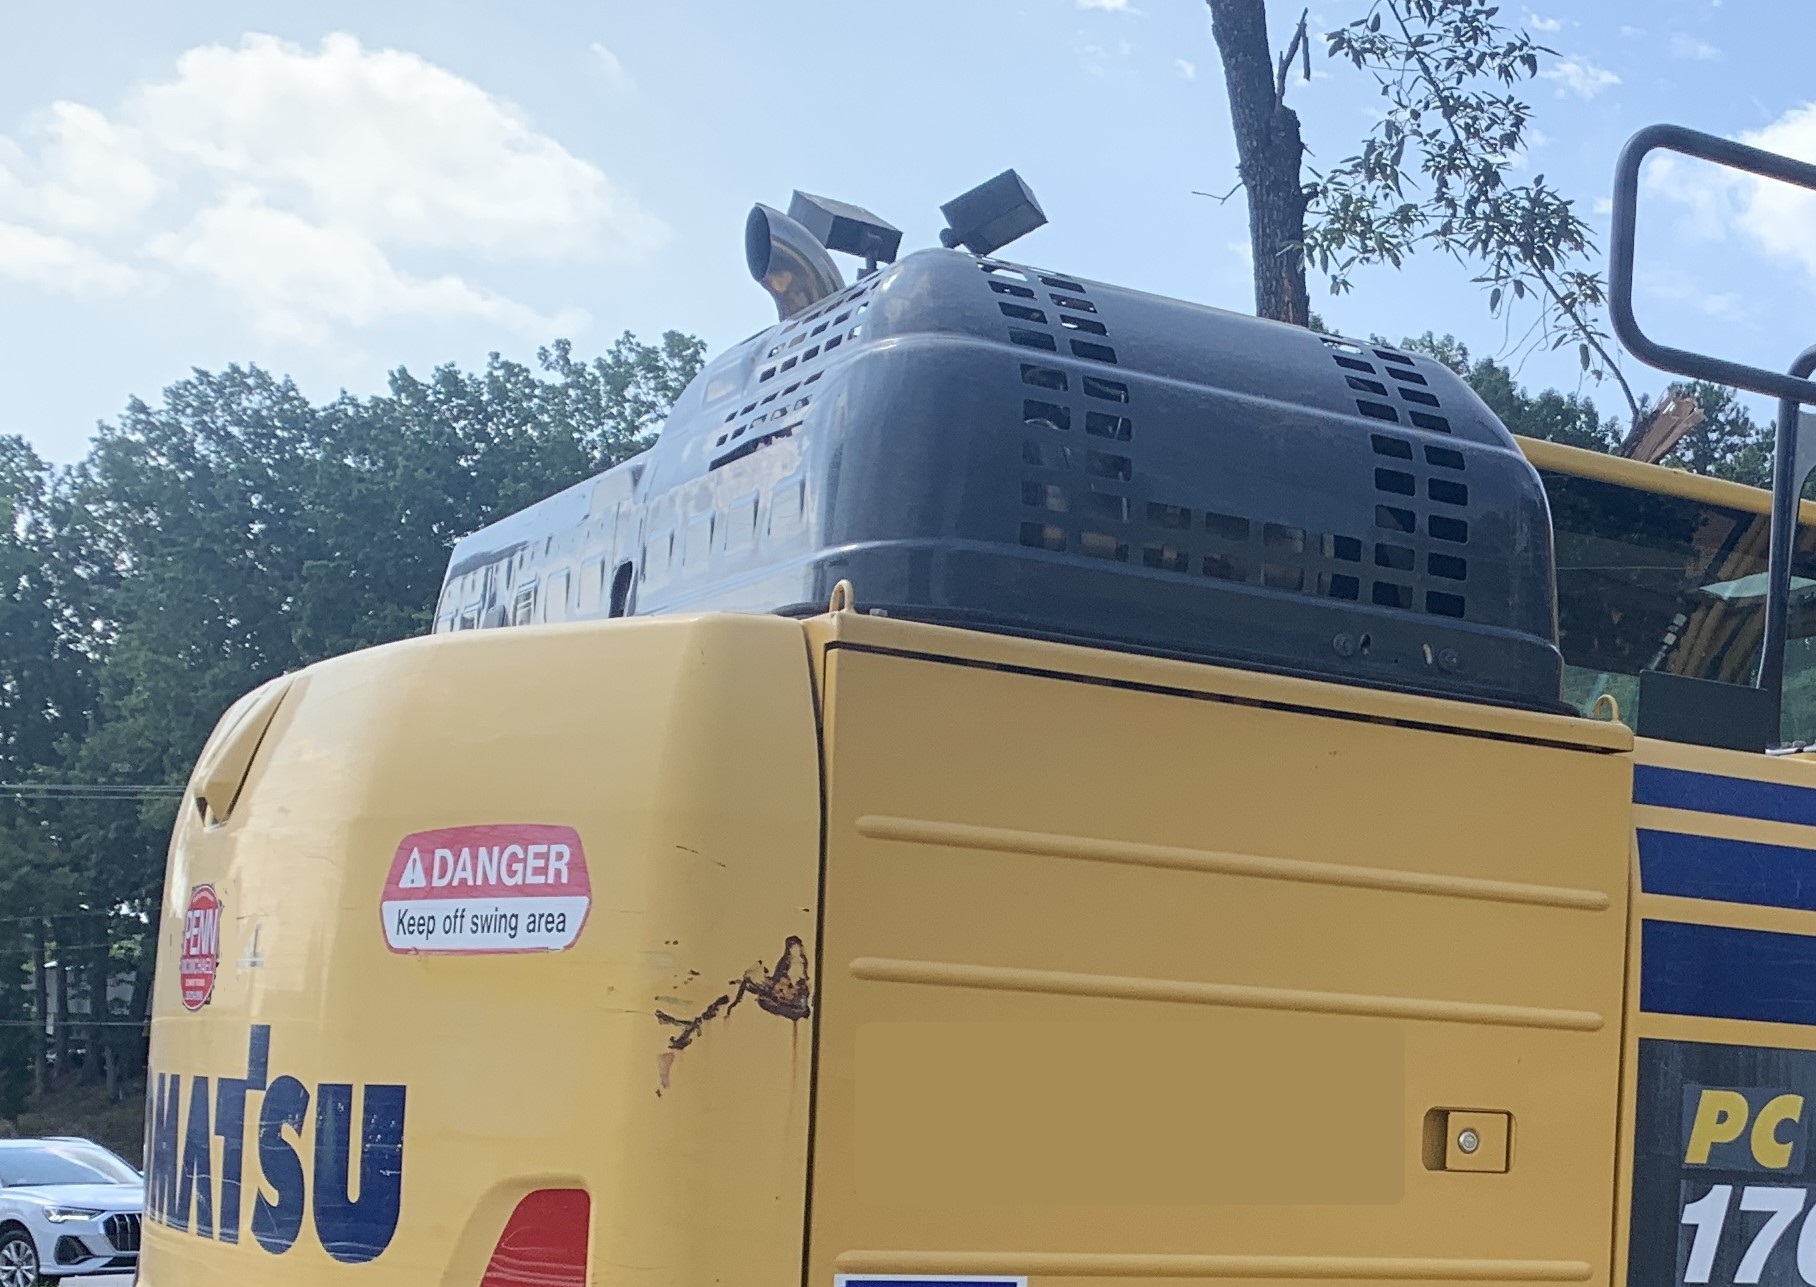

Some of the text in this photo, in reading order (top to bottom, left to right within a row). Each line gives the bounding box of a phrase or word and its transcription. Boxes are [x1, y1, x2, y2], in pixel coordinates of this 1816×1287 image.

[432, 844, 571, 887] DANGER
[183, 909, 219, 956] PENN
[396, 907, 566, 941] Keep off swing area
[144, 1024, 407, 1264] MATSU
[1684, 1089, 1805, 1169] PC
